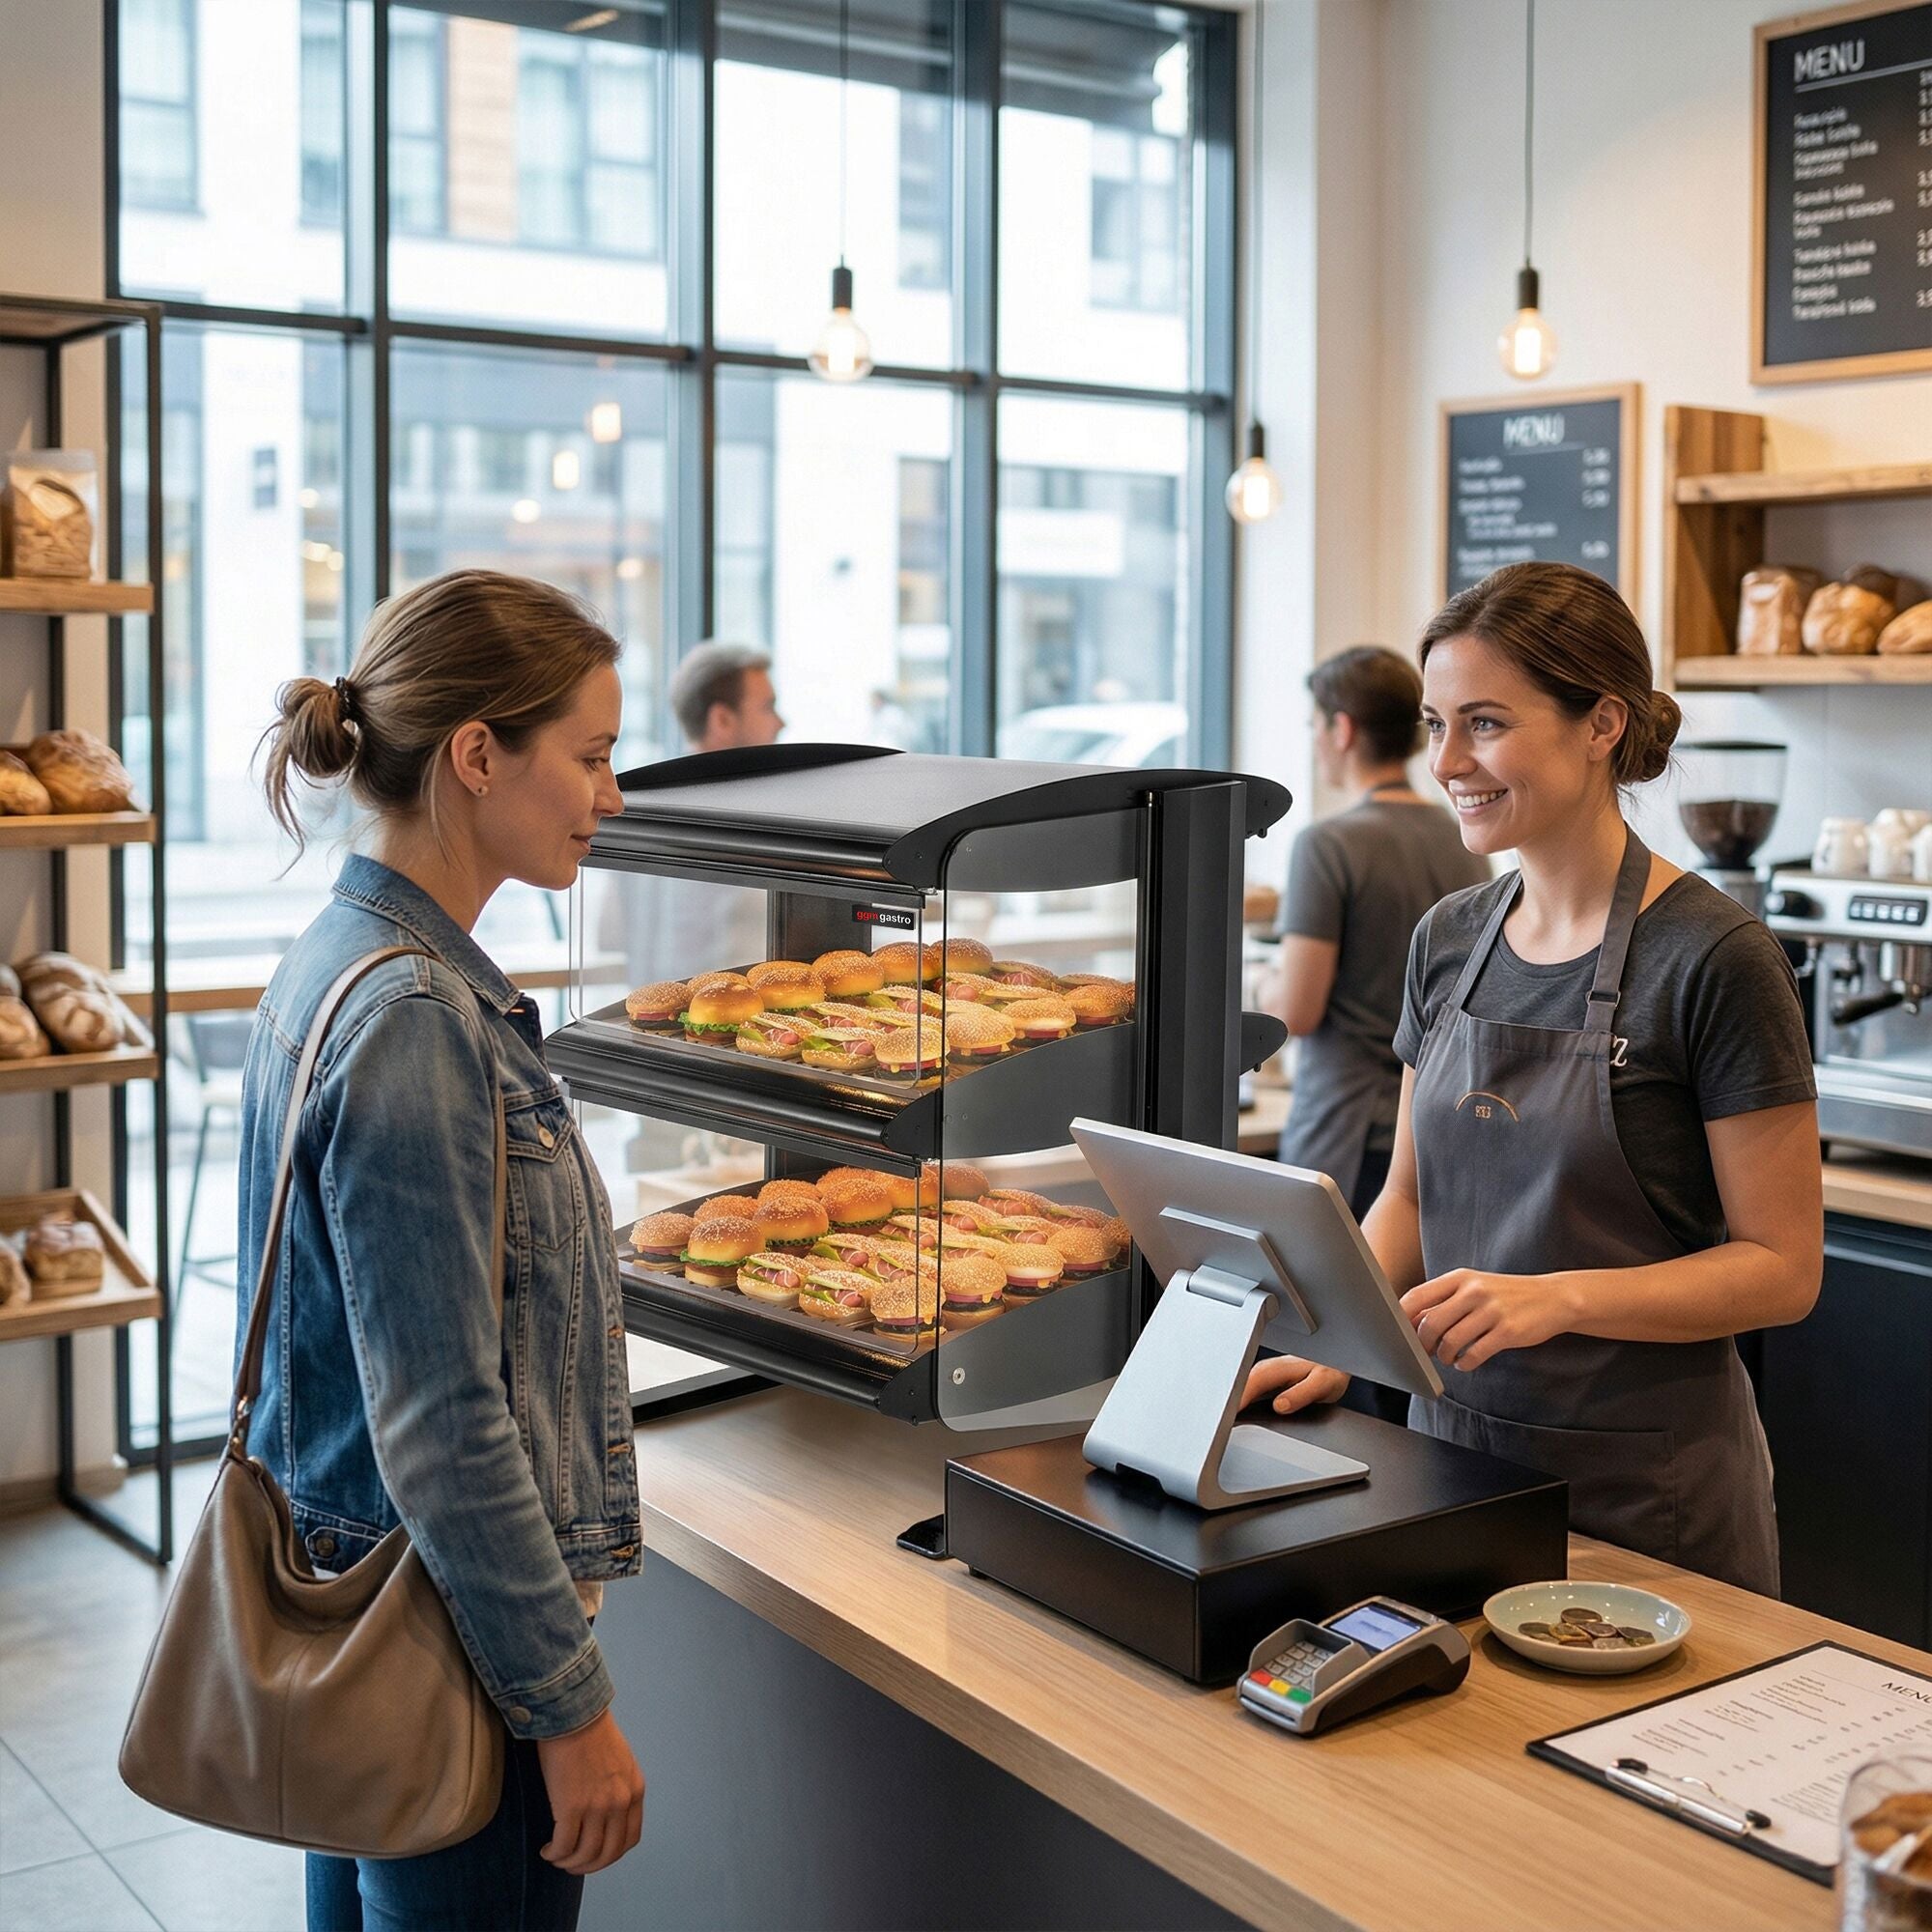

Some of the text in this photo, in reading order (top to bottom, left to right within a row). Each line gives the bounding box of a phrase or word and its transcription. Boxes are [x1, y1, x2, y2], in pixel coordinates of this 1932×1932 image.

[1795, 39, 1864, 83] MENU
[1503, 413, 1565, 448] MENU
[879, 913, 911, 923] gastro
